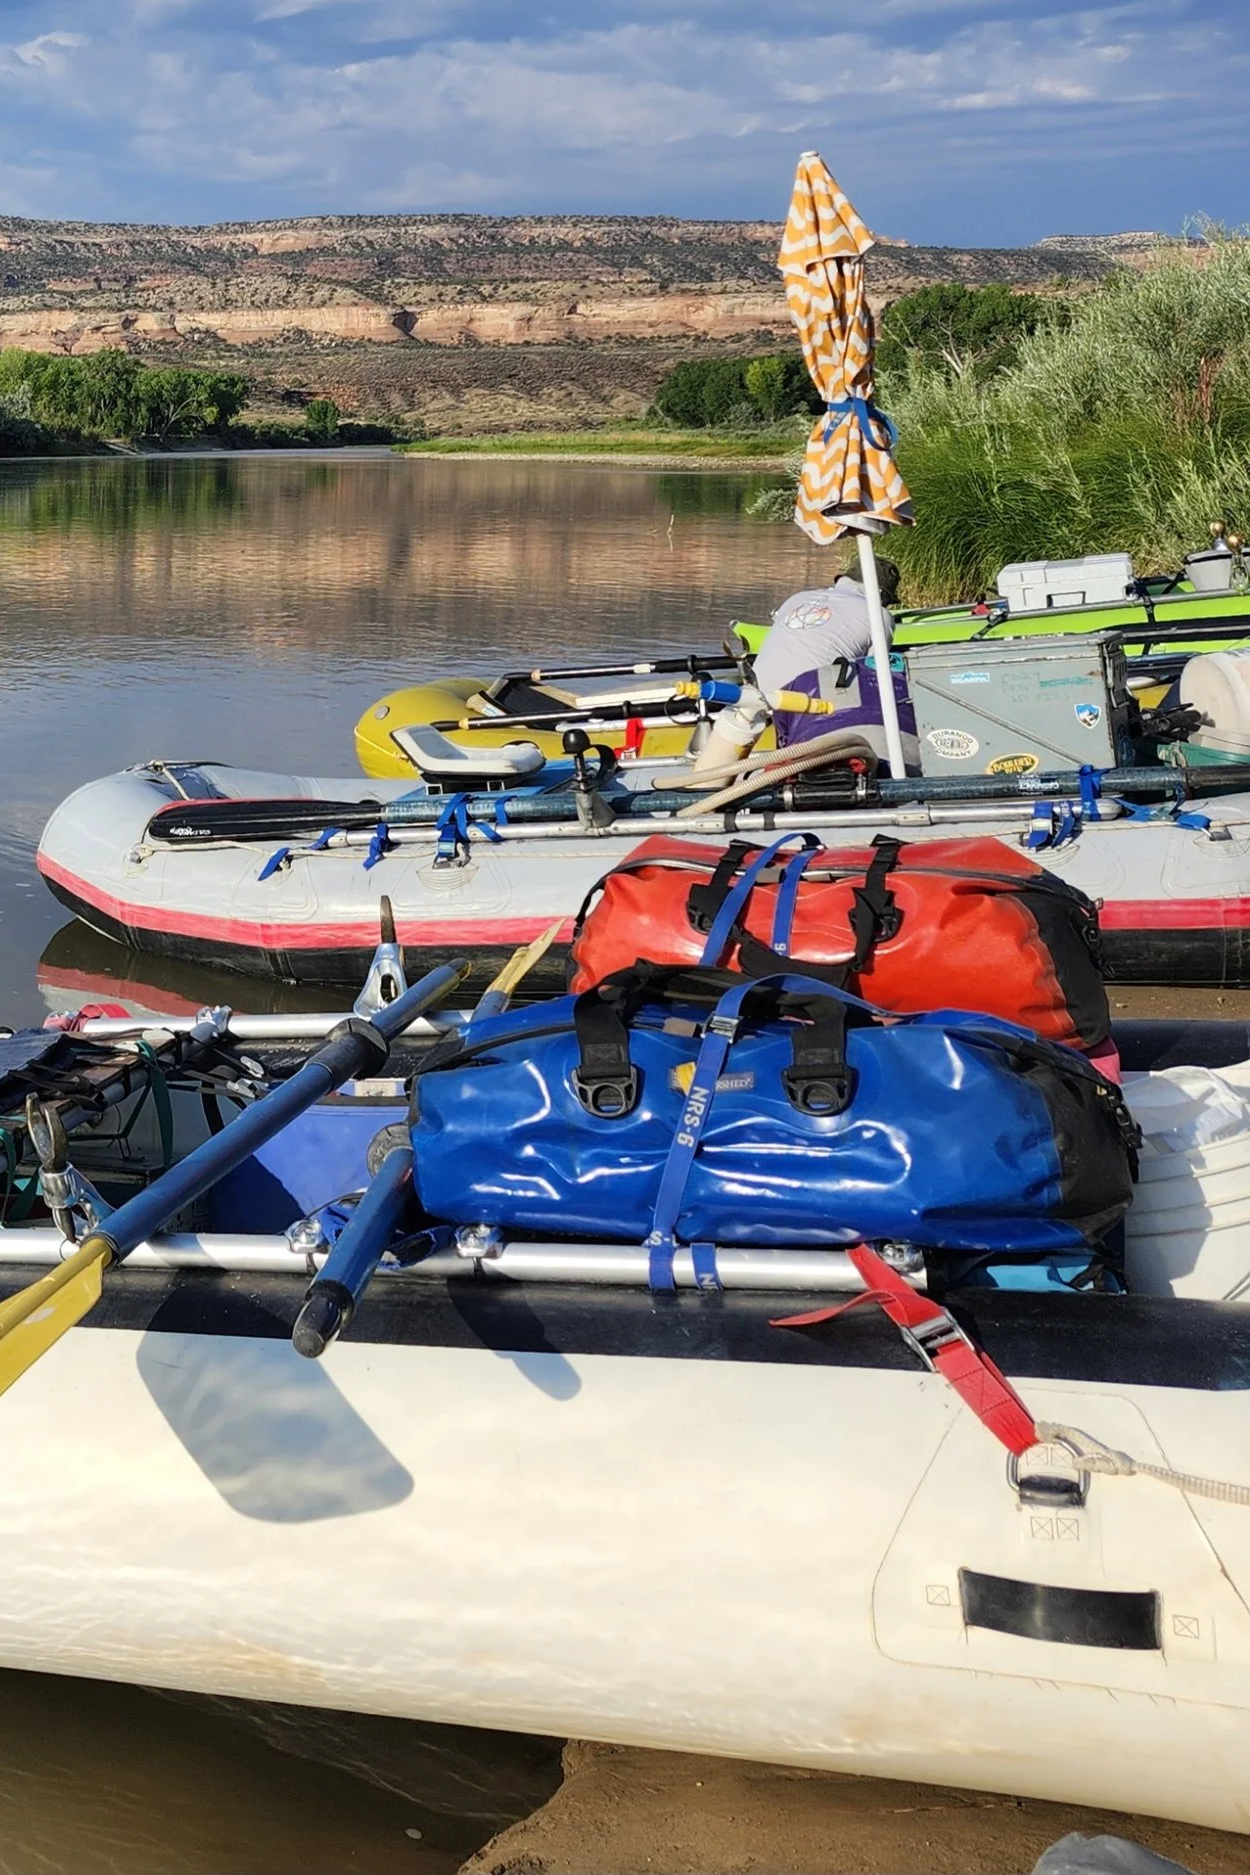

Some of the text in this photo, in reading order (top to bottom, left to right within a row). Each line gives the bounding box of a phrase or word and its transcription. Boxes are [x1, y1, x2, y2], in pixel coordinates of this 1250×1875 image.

[932, 730, 973, 744] DURANGO
[936, 749, 971, 758] OMPANY
[677, 1086, 710, 1148] NRS-6
